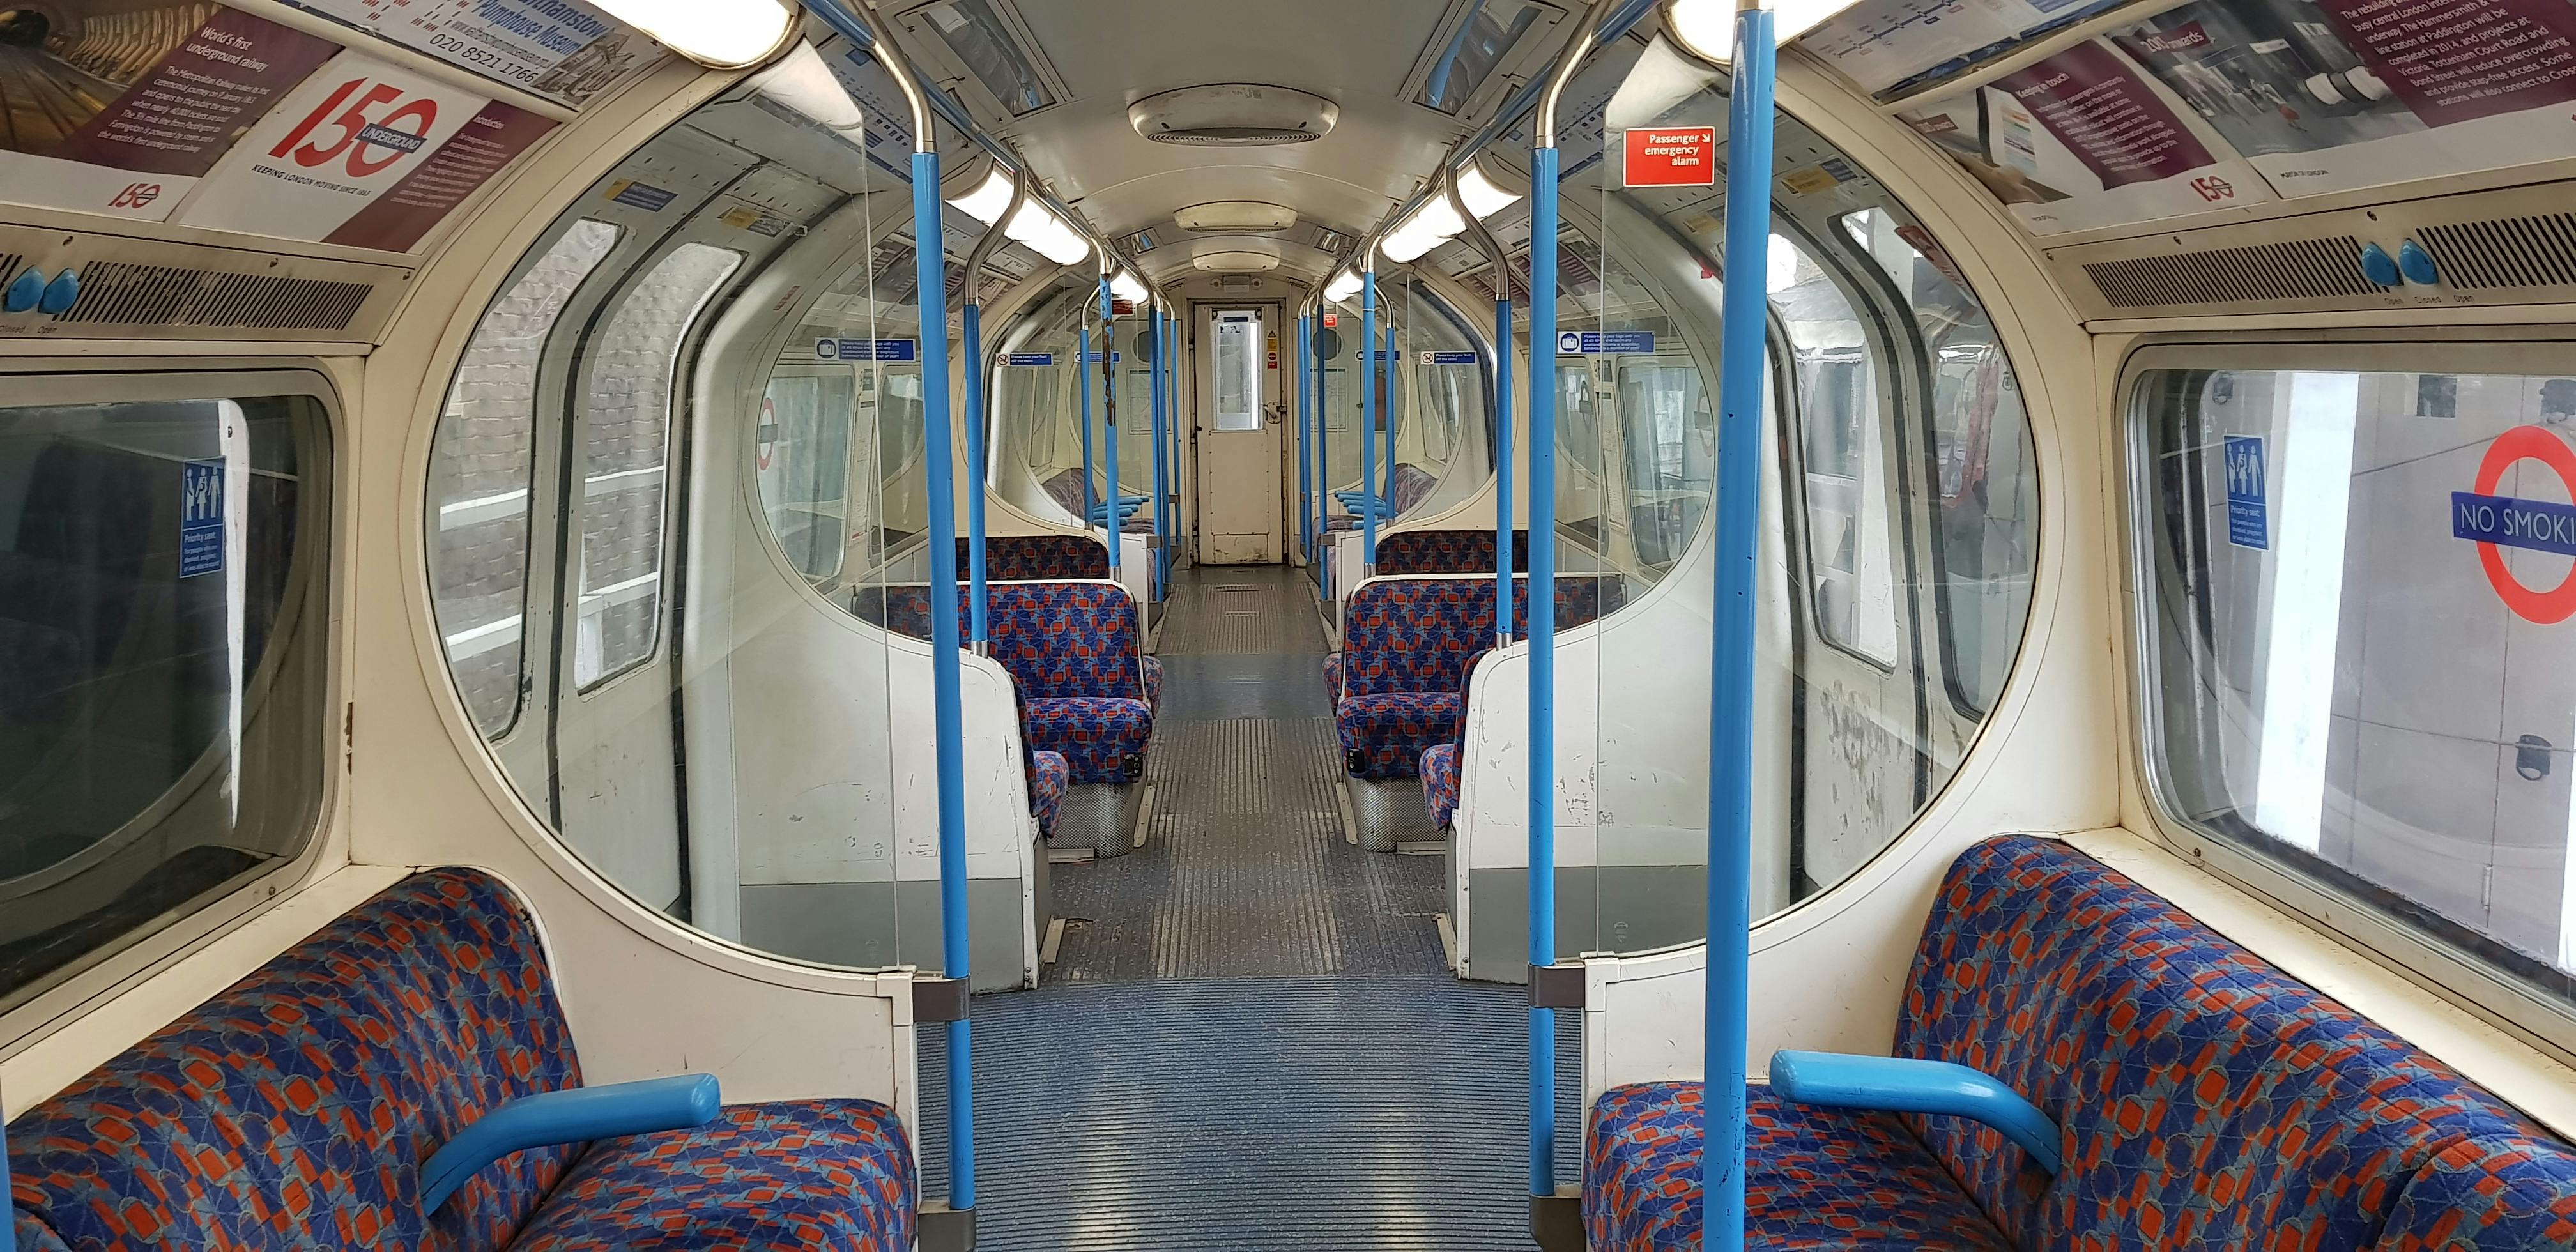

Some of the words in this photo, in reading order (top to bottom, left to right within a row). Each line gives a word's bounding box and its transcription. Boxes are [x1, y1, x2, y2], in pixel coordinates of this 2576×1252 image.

[2340, 10, 2359, 19] The
[2352, 21, 2374, 32] busy
[2372, 11, 2400, 26] central
[2396, 4, 2430, 18] London
[2400, 22, 2419, 32] The
[2416, 2, 2480, 27] Hammersmith
[201, 27, 234, 45] World's
[232, 36, 253, 50] first
[471, 0, 543, 38] Pumphouse
[532, 25, 582, 56] Museum
[2374, 46, 2392, 55] line
[2390, 38, 2419, 51] station
[2417, 34, 2429, 43] at
[2425, 20, 2476, 40] Paddington
[2474, 12, 2495, 24] will
[2490, 8, 2508, 18] be
[2388, 49, 2430, 66] completed
[2460, 33, 2480, 45] and
[2478, 21, 2518, 41] projects
[2517, 16, 2531, 26] at
[2429, 52, 2477, 68] Tottenham
[2474, 42, 2504, 56] Court
[2500, 33, 2529, 47] Road
[2527, 25, 2549, 39] and
[187, 43, 243, 64] underground
[239, 58, 269, 72] railway
[429, 33, 464, 52] 020
[461, 47, 503, 69] 8521
[499, 63, 539, 82] 1766
[2409, 75, 2434, 87] Bond
[2456, 66, 2474, 75] will
[2471, 59, 2504, 72] reduce
[2503, 37, 2570, 63] overcrowding
[2016, 86, 2044, 98] Keeping
[2045, 73, 2070, 87] touch
[2424, 87, 2441, 96] and
[2469, 72, 2509, 86] step-free
[2540, 52, 2573, 66] Some
[2501, 78, 2540, 93] connect
[2536, 75, 2550, 84] to
[268, 77, 438, 178] 150
[362, 126, 420, 149] UNDERGROUND
[1650, 134, 1699, 145] Passenger
[1644, 146, 1699, 156] emergency
[1671, 156, 1699, 166] alarm
[252, 164, 285, 178] KEEPING
[284, 173, 315, 185] LONDON
[107, 183, 160, 208] 150
[2190, 176, 2234, 202] 150
[2453, 294, 2474, 303] Open
[2230, 504, 2247, 517] Priority
[2461, 503, 2494, 533] NO
[185, 533, 203, 543] Priority
